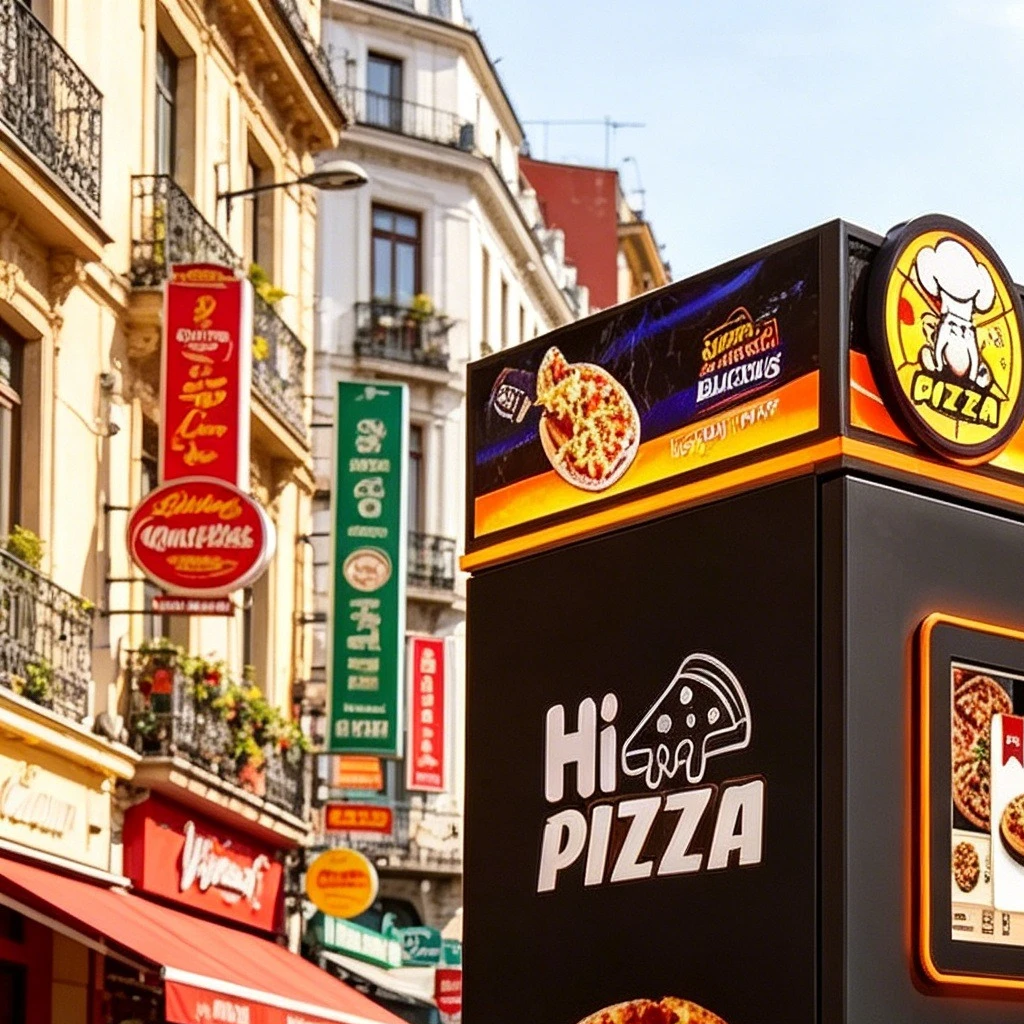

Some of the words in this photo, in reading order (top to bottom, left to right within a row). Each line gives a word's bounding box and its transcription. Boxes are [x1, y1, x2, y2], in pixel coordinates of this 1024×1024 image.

[912, 372, 1000, 428] PIZZA
[545, 692, 618, 803] Hi
[537, 779, 764, 892] PIZZA
